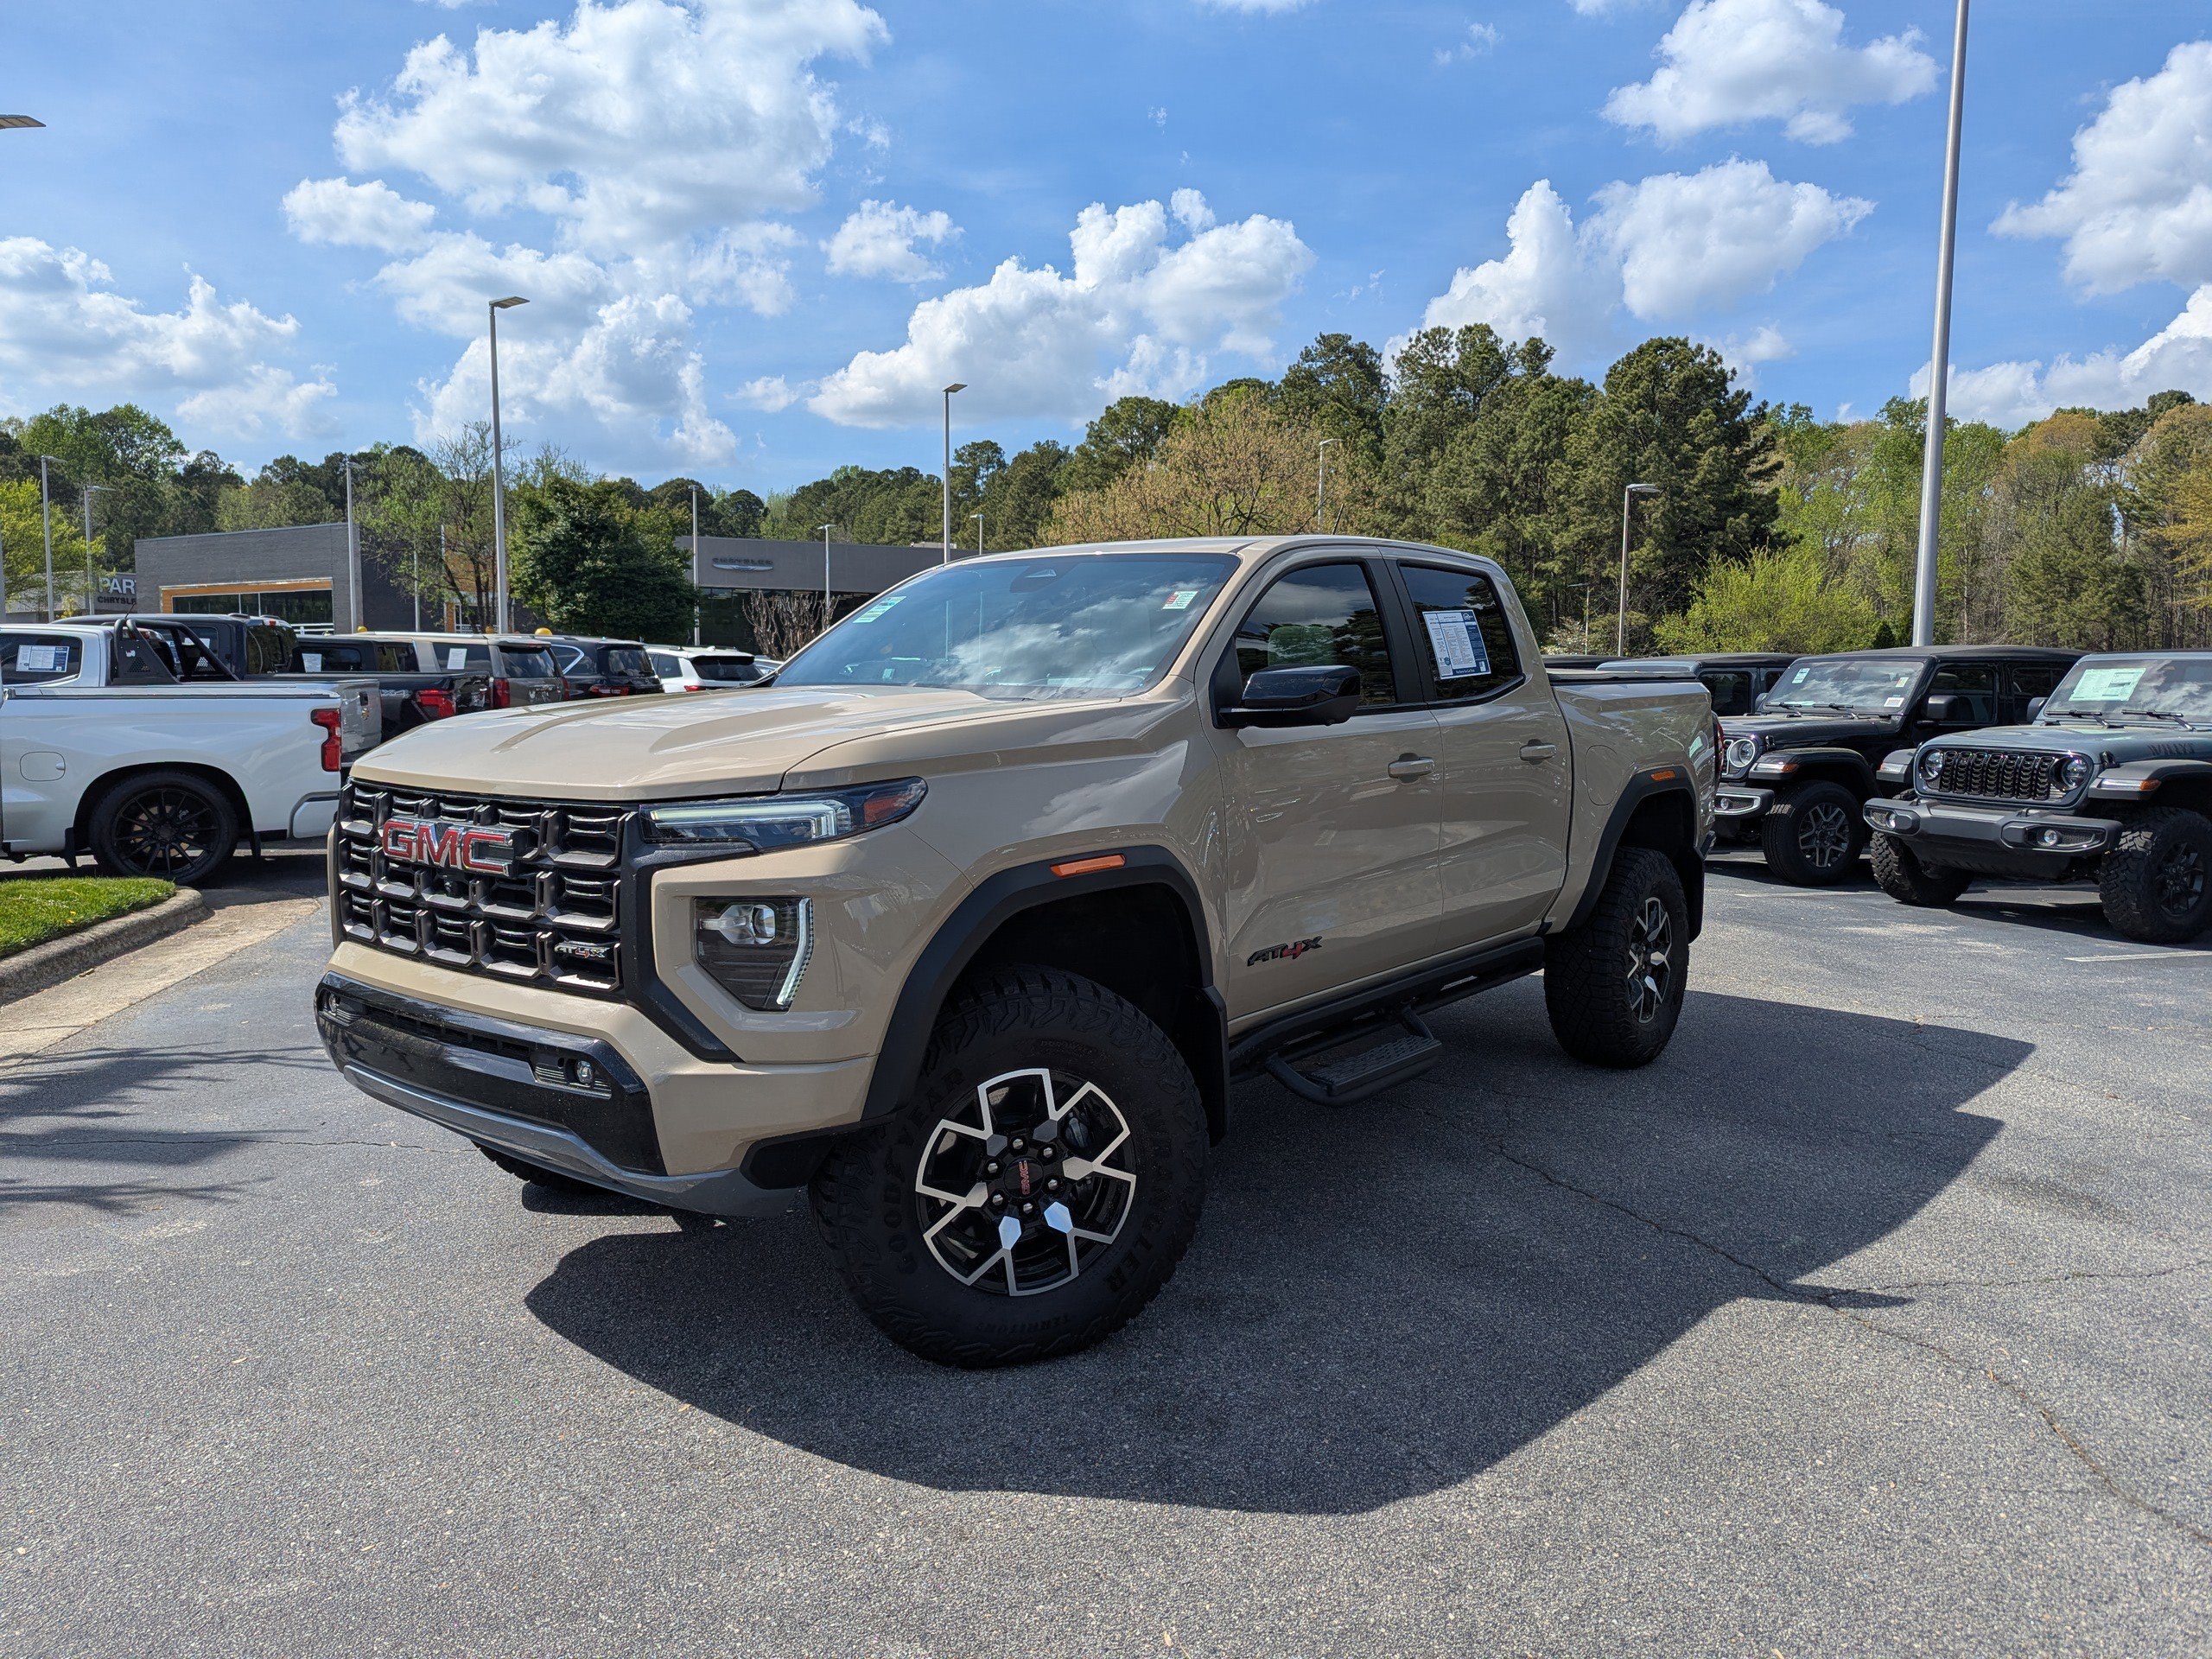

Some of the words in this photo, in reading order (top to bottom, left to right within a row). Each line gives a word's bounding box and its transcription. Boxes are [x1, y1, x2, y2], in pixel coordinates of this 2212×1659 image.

[99, 576, 137, 594] PAR
[383, 818, 514, 877] GMC
[554, 940, 610, 958] AT4X
[1247, 936, 1323, 967] AT4X
[1019, 1160, 1031, 1195] GMC
